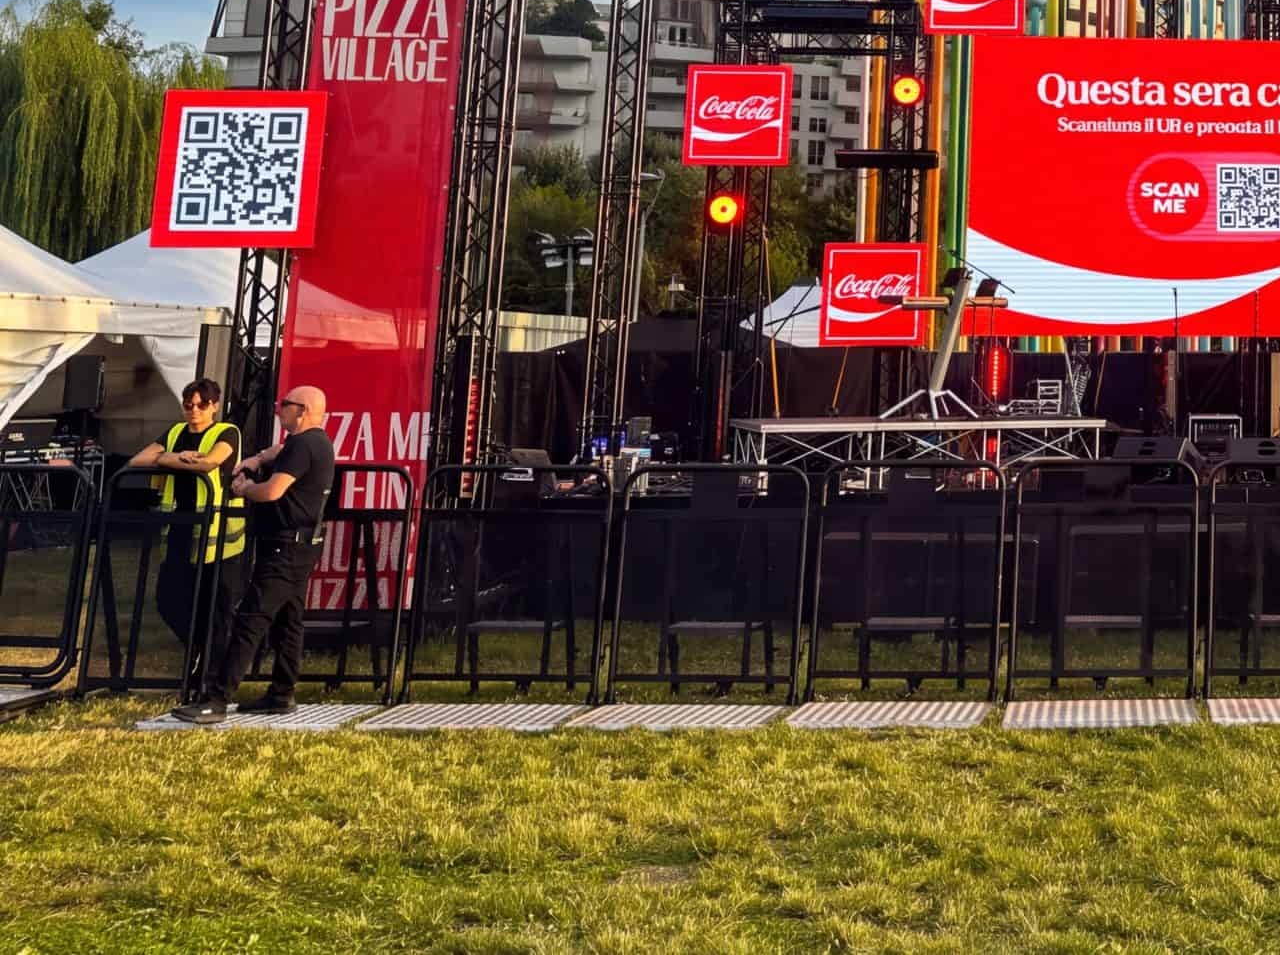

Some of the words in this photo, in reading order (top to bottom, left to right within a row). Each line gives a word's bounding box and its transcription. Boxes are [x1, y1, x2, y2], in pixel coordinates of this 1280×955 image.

[322, 37, 449, 83] VILLAGE
[1037, 73, 1167, 108] Questa
[1174, 82, 1252, 107] sera
[699, 95, 779, 120] Coca-Cola
[1184, 121, 1194, 133] e
[1140, 182, 1200, 197] SCAN
[1153, 199, 1186, 213] ME
[834, 274, 914, 299] Coca-Cola
